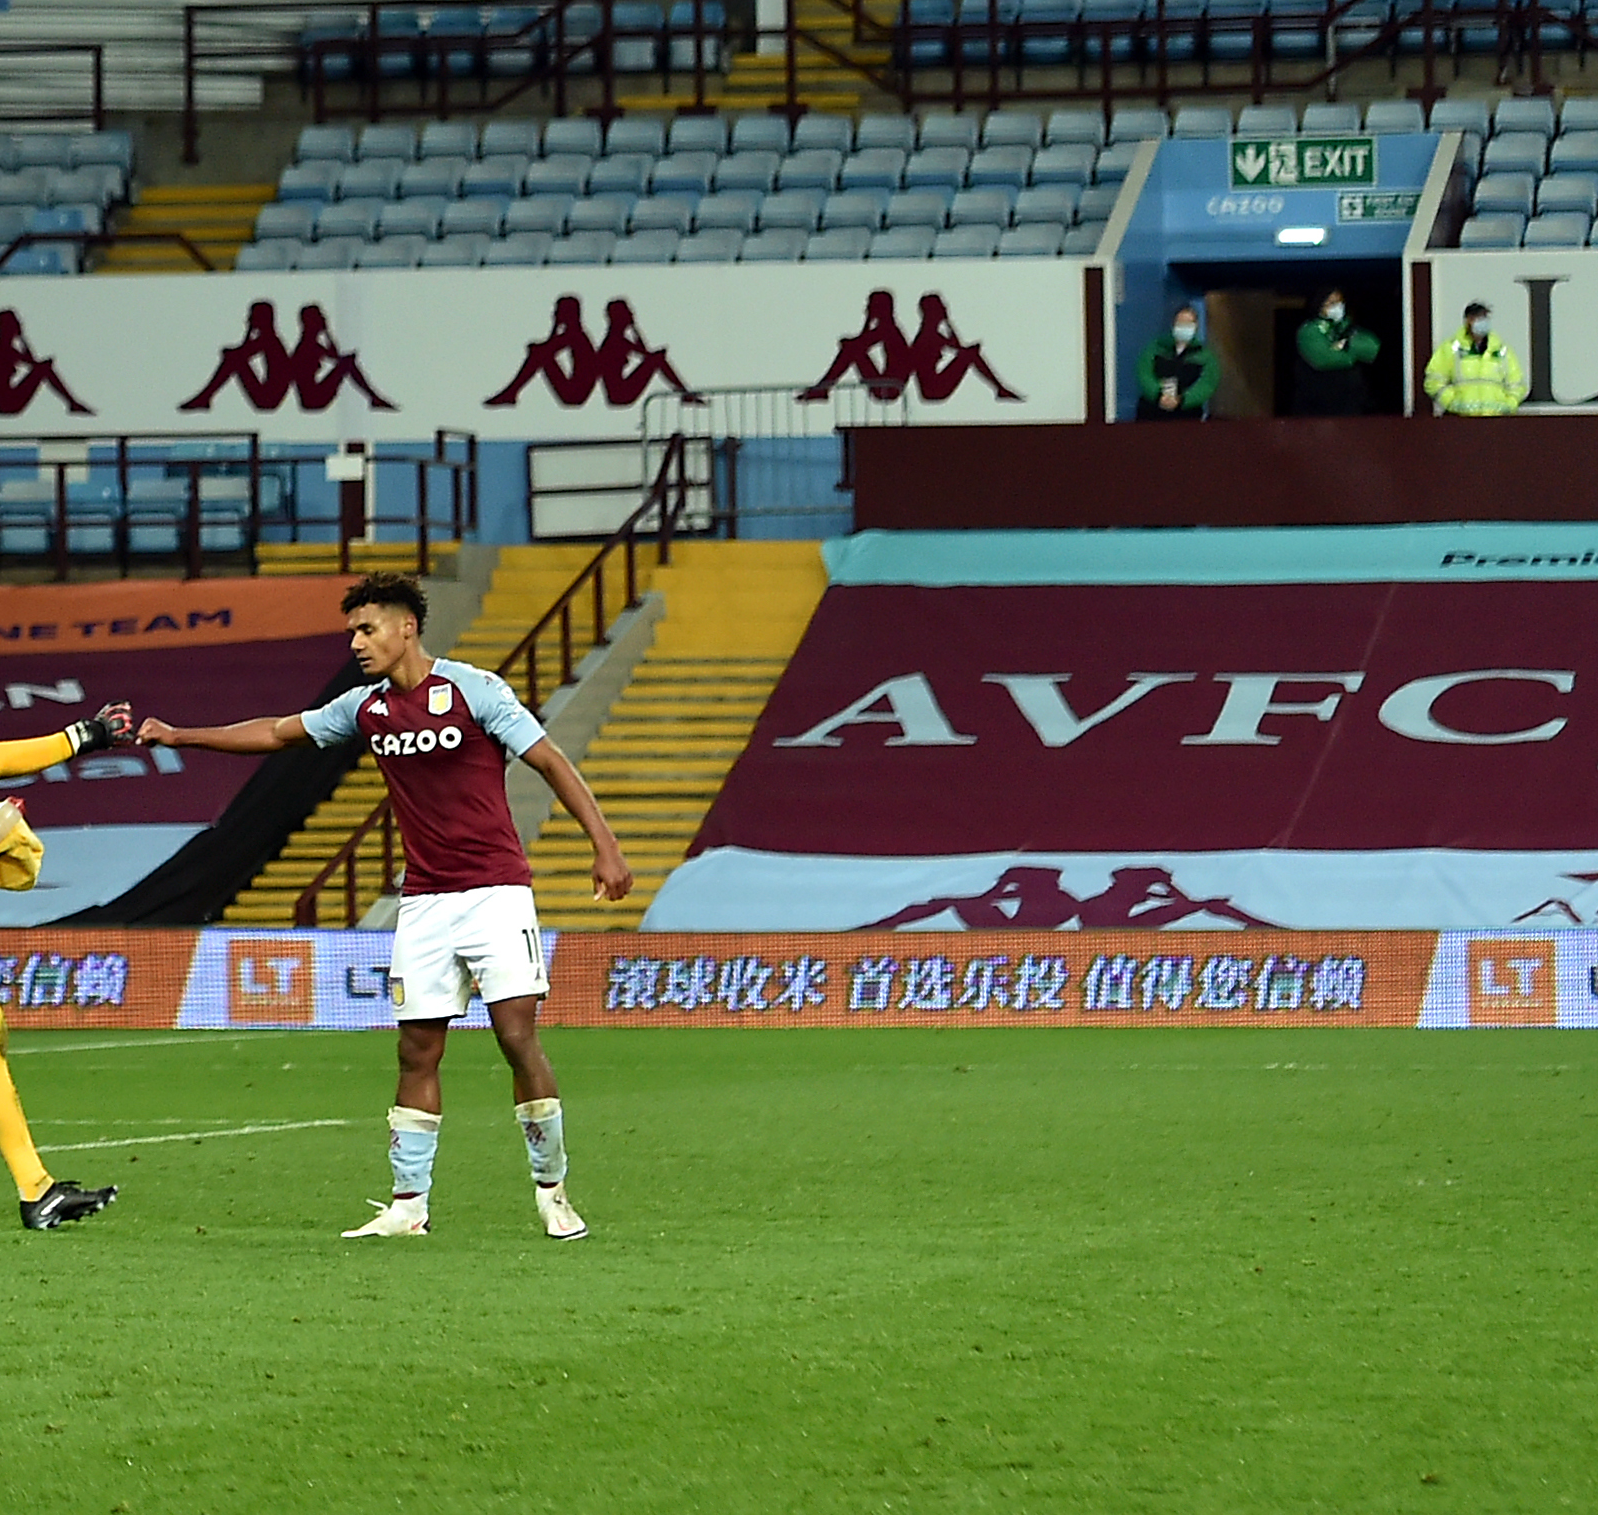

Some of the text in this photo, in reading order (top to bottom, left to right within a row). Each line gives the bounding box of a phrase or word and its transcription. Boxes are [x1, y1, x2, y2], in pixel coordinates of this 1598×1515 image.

[1303, 144, 1371, 179] EXIT
[72, 607, 234, 638] TEAM
[773, 670, 1577, 748] AVFC
[371, 725, 462, 756] CAZOO
[239, 956, 302, 996] LT
[605, 954, 1367, 1012] 滚球收米 首选乐投 值得您信赖
[1479, 957, 1544, 997] LT
